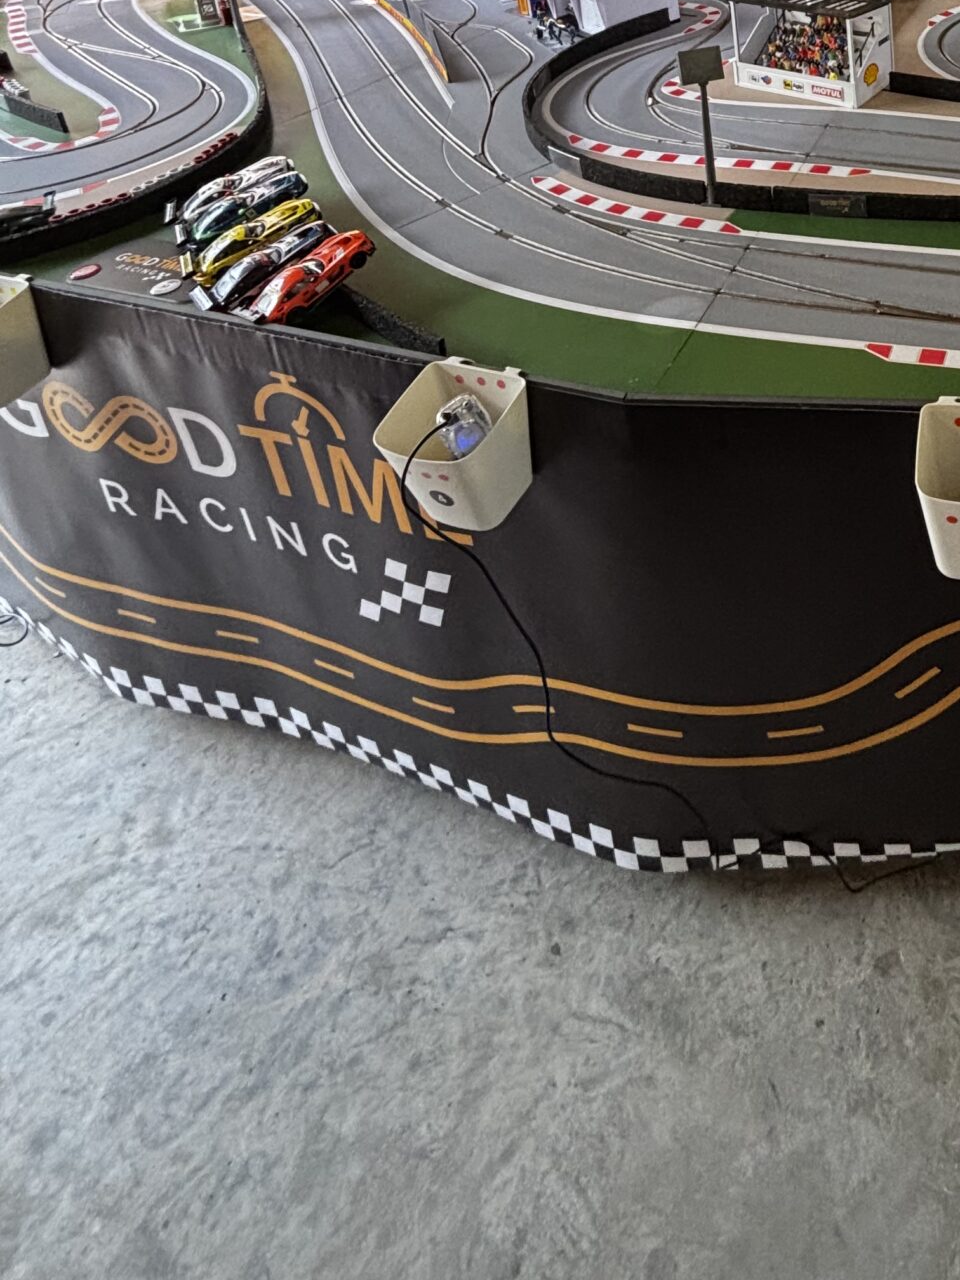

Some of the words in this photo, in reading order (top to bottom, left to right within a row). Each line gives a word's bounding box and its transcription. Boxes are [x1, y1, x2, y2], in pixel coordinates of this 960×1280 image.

[812, 86, 842, 99] MOTUL
[115, 252, 160, 266] GOOD
[116, 264, 159, 276] RACING
[99, 477, 359, 574] RACING
